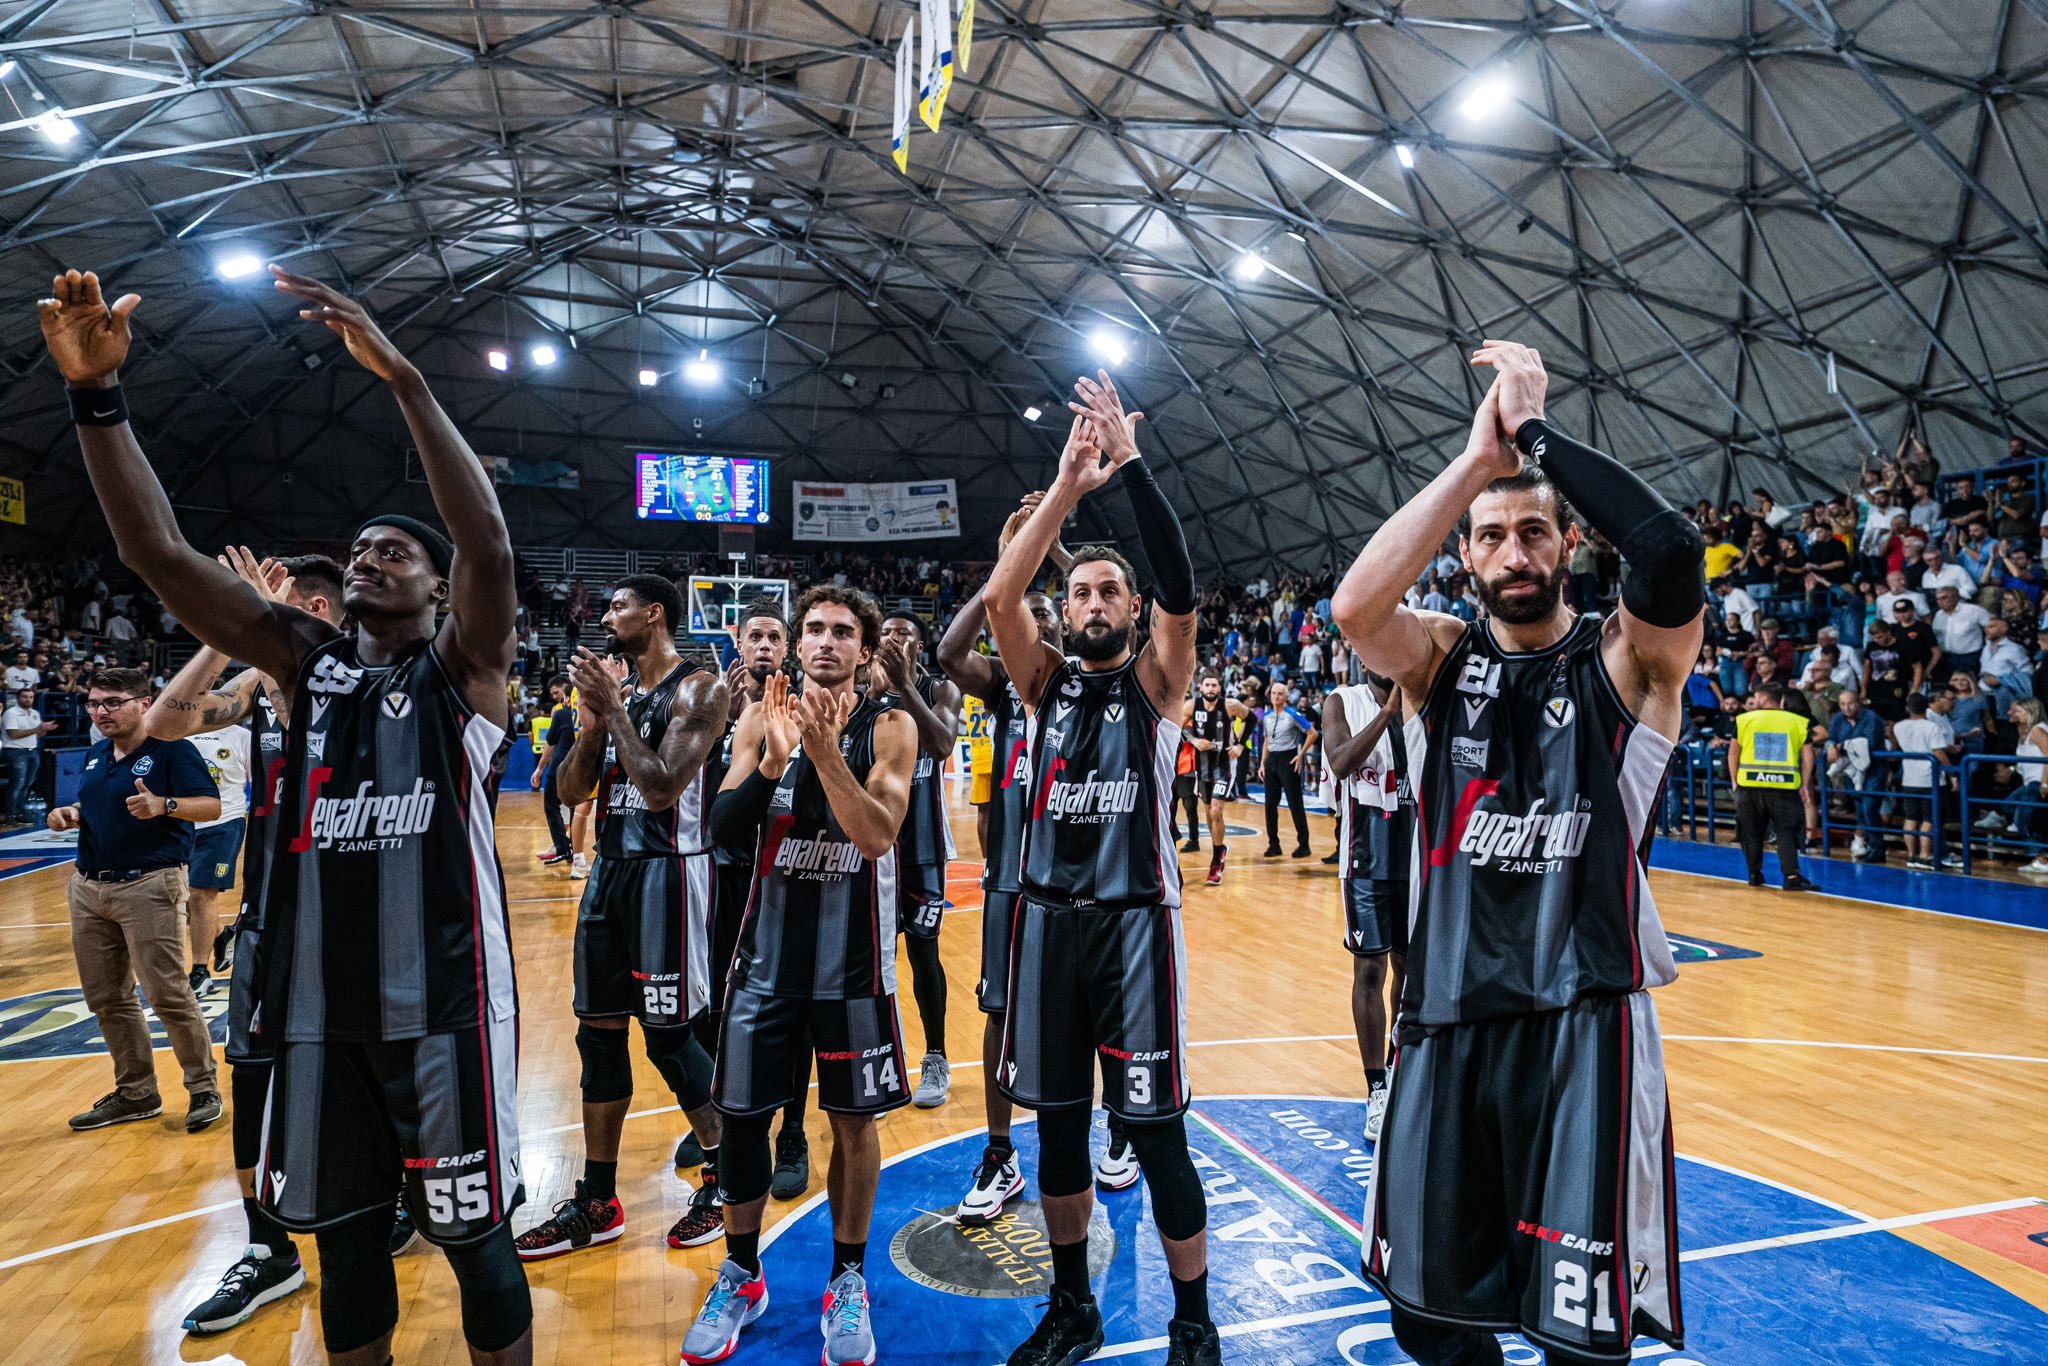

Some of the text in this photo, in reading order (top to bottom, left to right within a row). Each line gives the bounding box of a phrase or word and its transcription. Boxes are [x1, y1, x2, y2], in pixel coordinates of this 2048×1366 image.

[1456, 653, 1502, 698] 21
[1451, 745, 1484, 756] SPORT
[1756, 772, 1785, 783] Ares
[1069, 814, 1117, 824] ZANETTI
[338, 838, 403, 852] ZANETTI
[798, 871, 842, 881] ZANETTI
[1499, 859, 1563, 874] ZANETTI
[913, 905, 940, 927] 15
[643, 985, 678, 1015] 25
[862, 1056, 900, 1097] 14
[1128, 1066, 1151, 1105] 3
[423, 1170, 490, 1224] 55
[1553, 1259, 1616, 1332] 21
